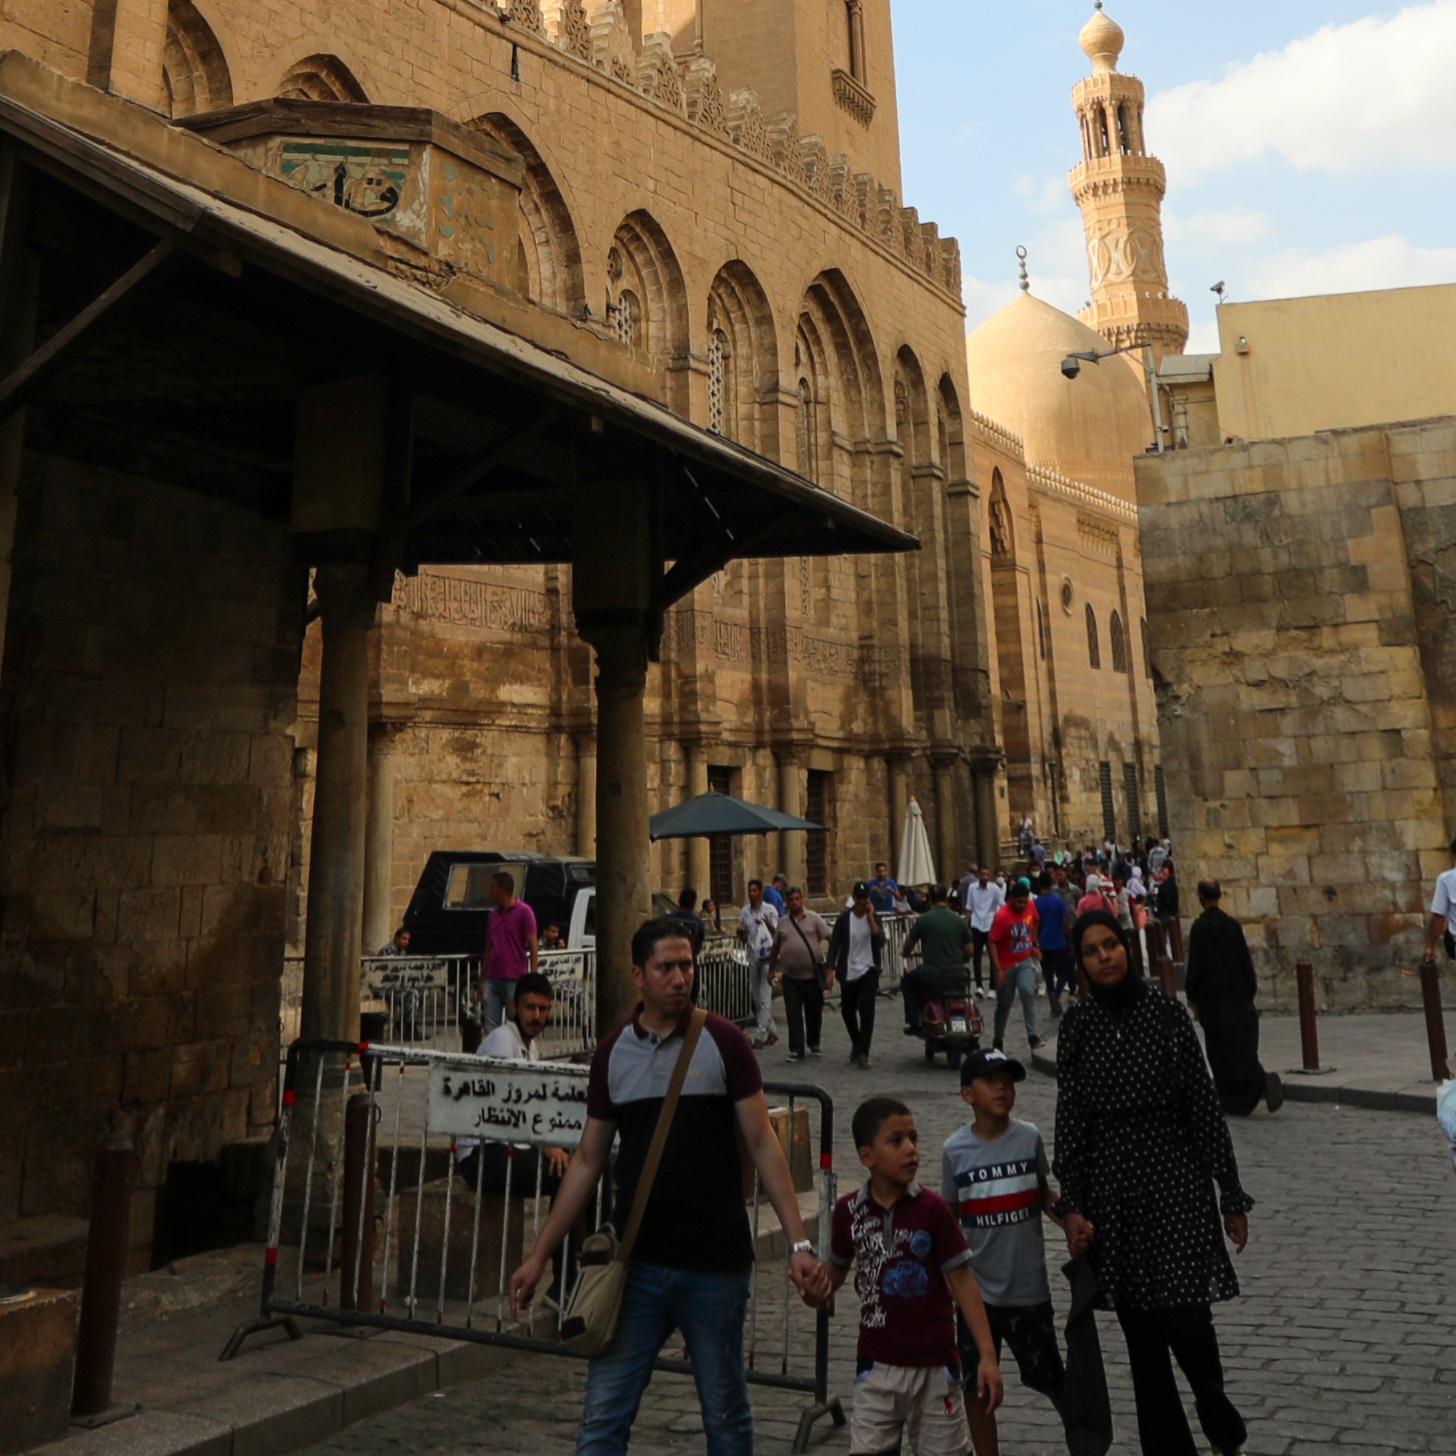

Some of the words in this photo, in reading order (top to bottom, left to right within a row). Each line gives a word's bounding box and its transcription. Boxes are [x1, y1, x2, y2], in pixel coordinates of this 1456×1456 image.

[442, 1076, 495, 1101] القاهرة
[532, 1111, 582, 1135] ممنوع
[968, 1161, 1027, 1182] TOMMY
